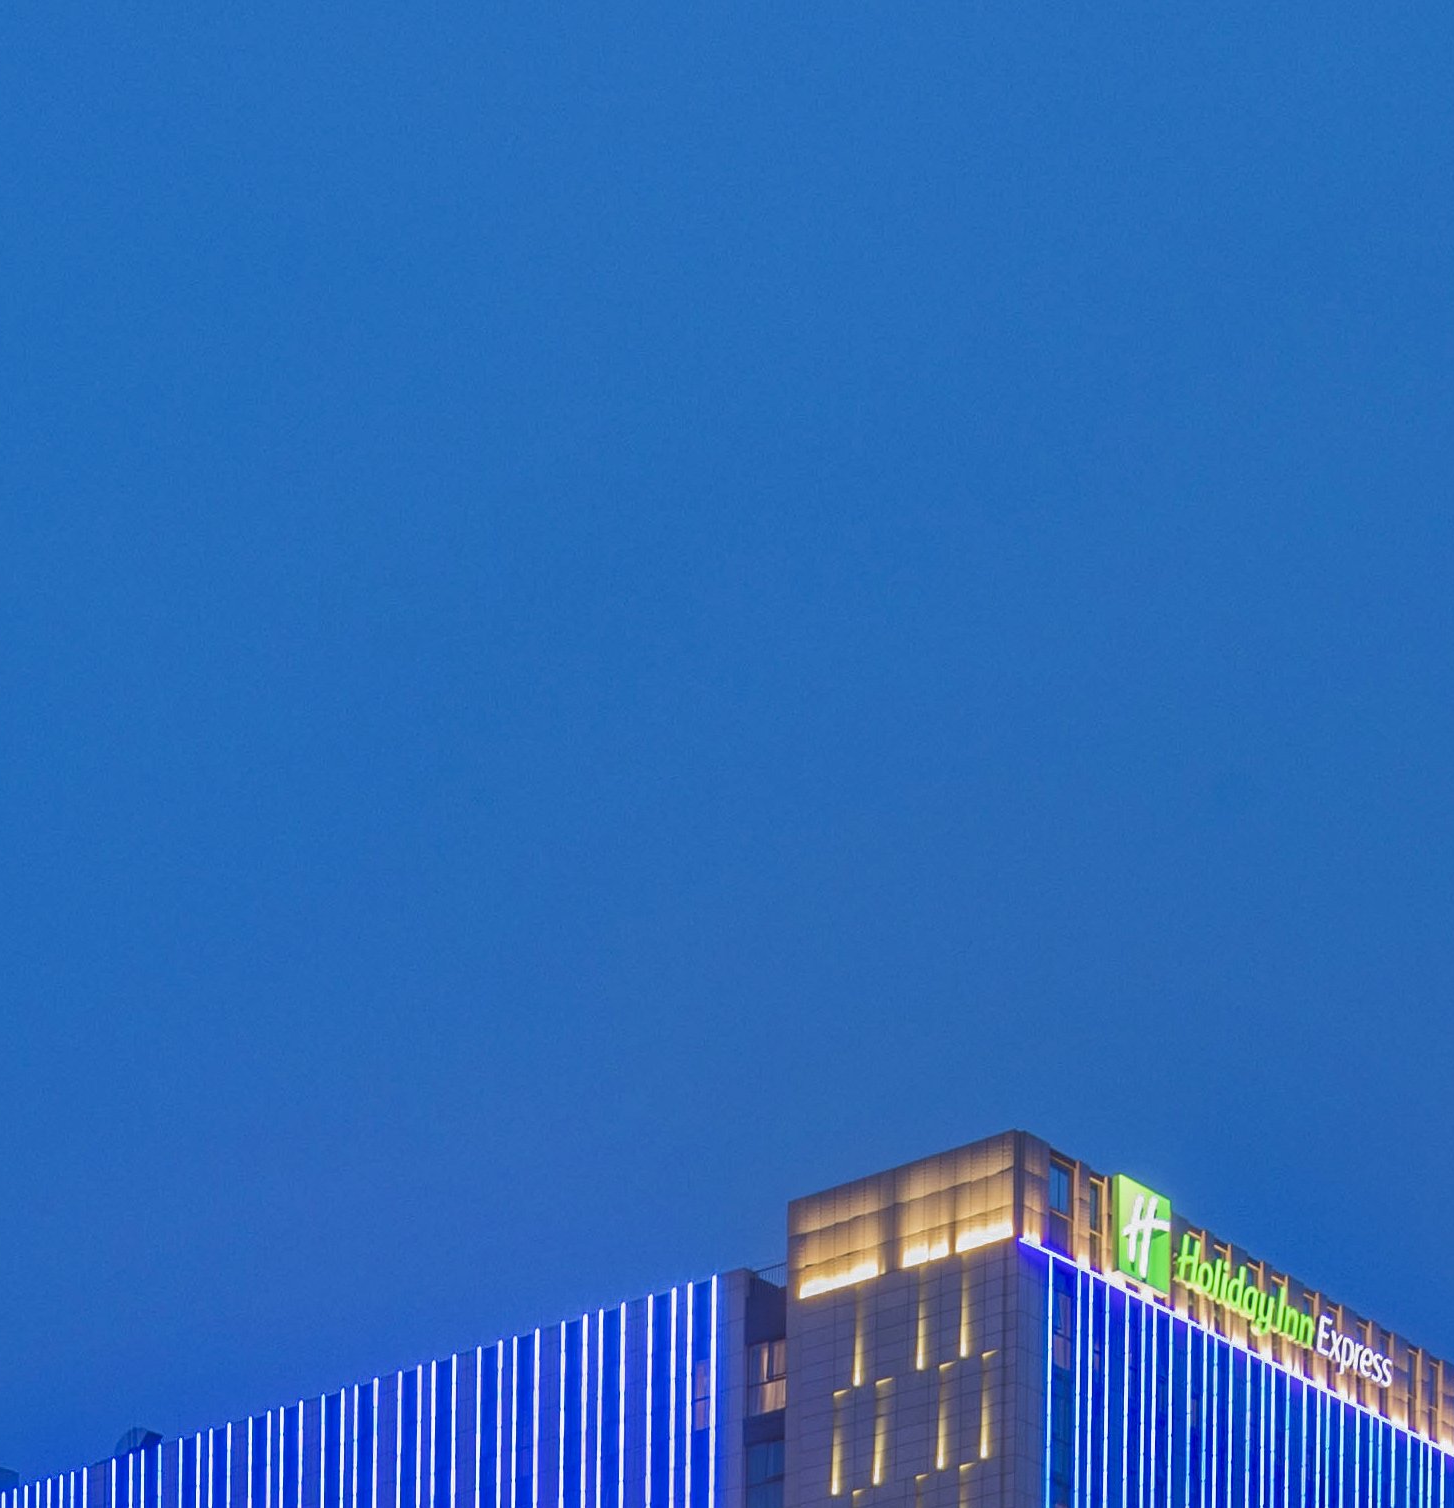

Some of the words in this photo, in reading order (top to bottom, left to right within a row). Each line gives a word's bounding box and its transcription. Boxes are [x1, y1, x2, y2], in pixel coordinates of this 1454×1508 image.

[1176, 1233, 1276, 1336] Holiday
[1272, 1287, 1314, 1350] Inn
[1316, 1315, 1394, 1388] Express
